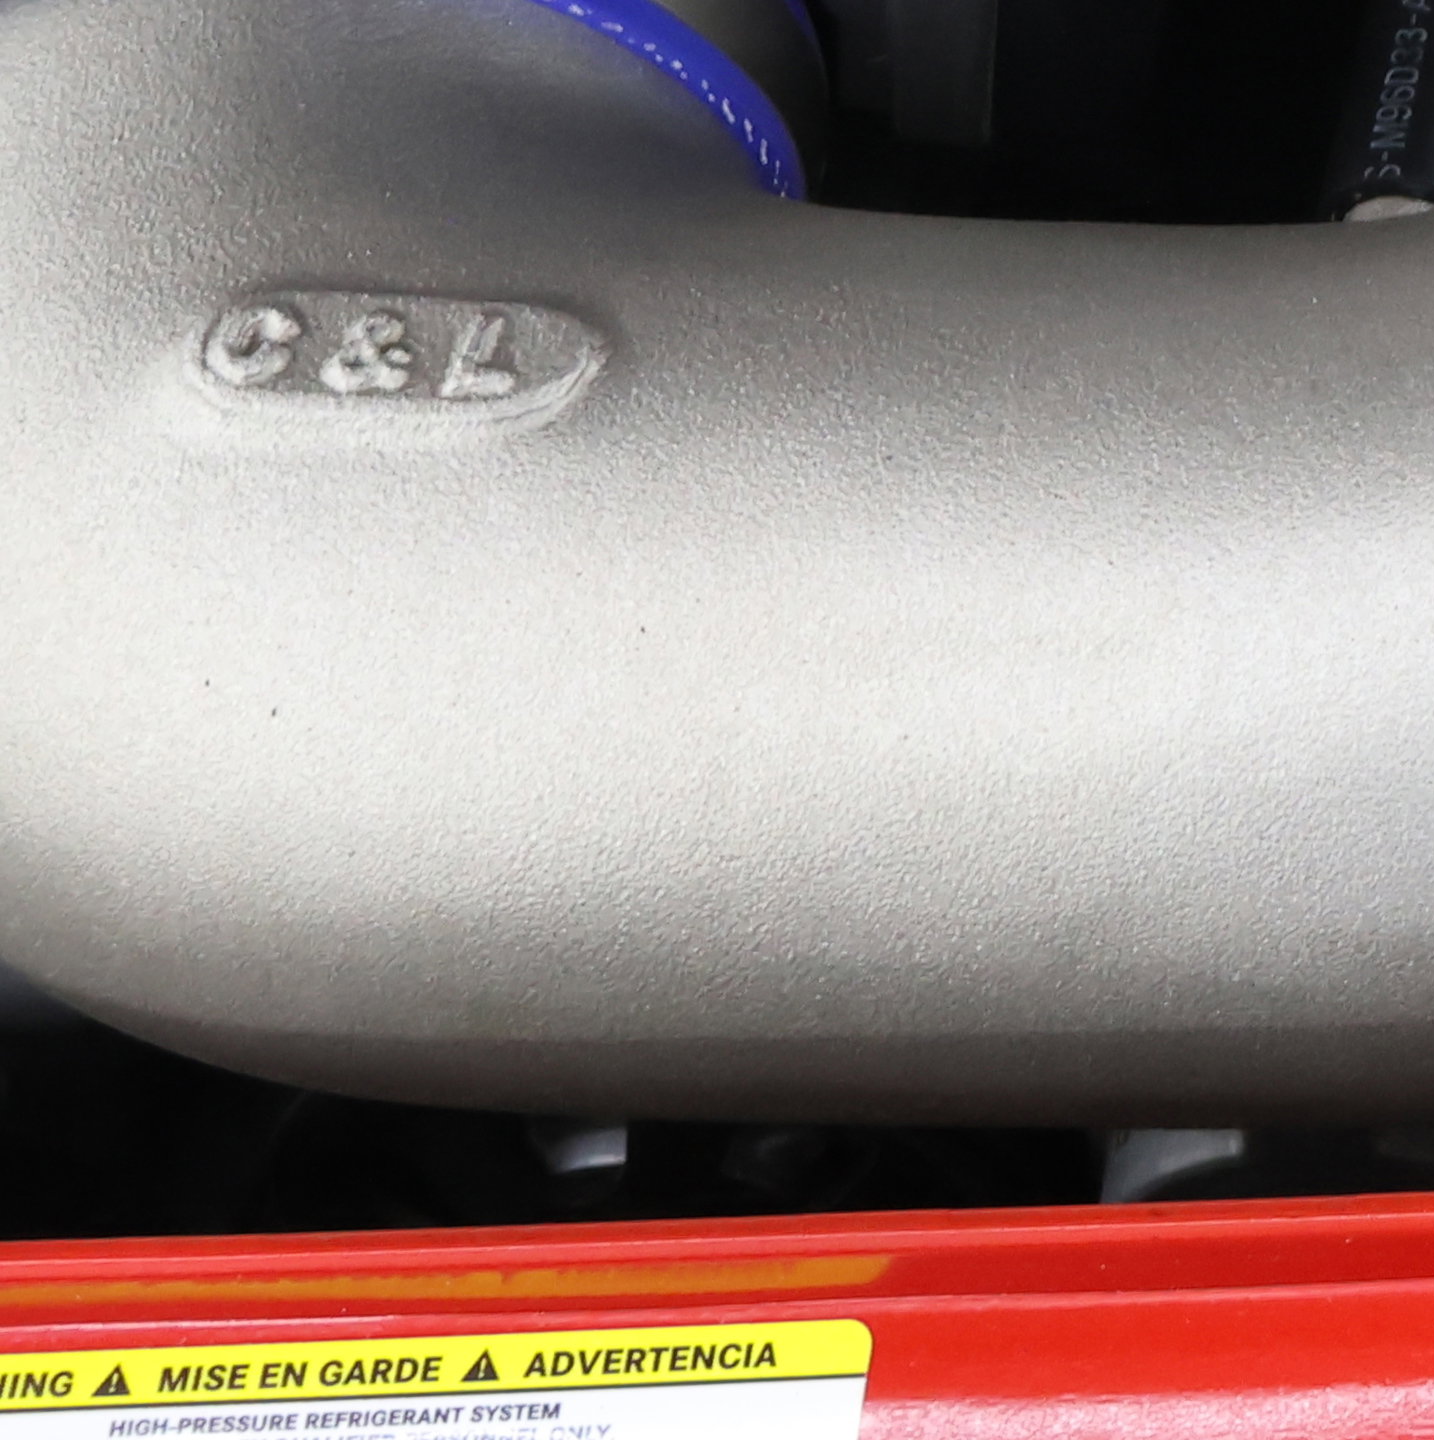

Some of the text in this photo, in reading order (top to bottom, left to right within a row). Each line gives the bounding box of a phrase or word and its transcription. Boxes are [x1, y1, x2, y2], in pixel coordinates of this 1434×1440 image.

[0, 1342, 777, 1400] ING MISE EN GARDE ADVERTENCIA
[108, 1402, 562, 1438] HIGH-PRESSURE REFRIGERANT SYSTEM
